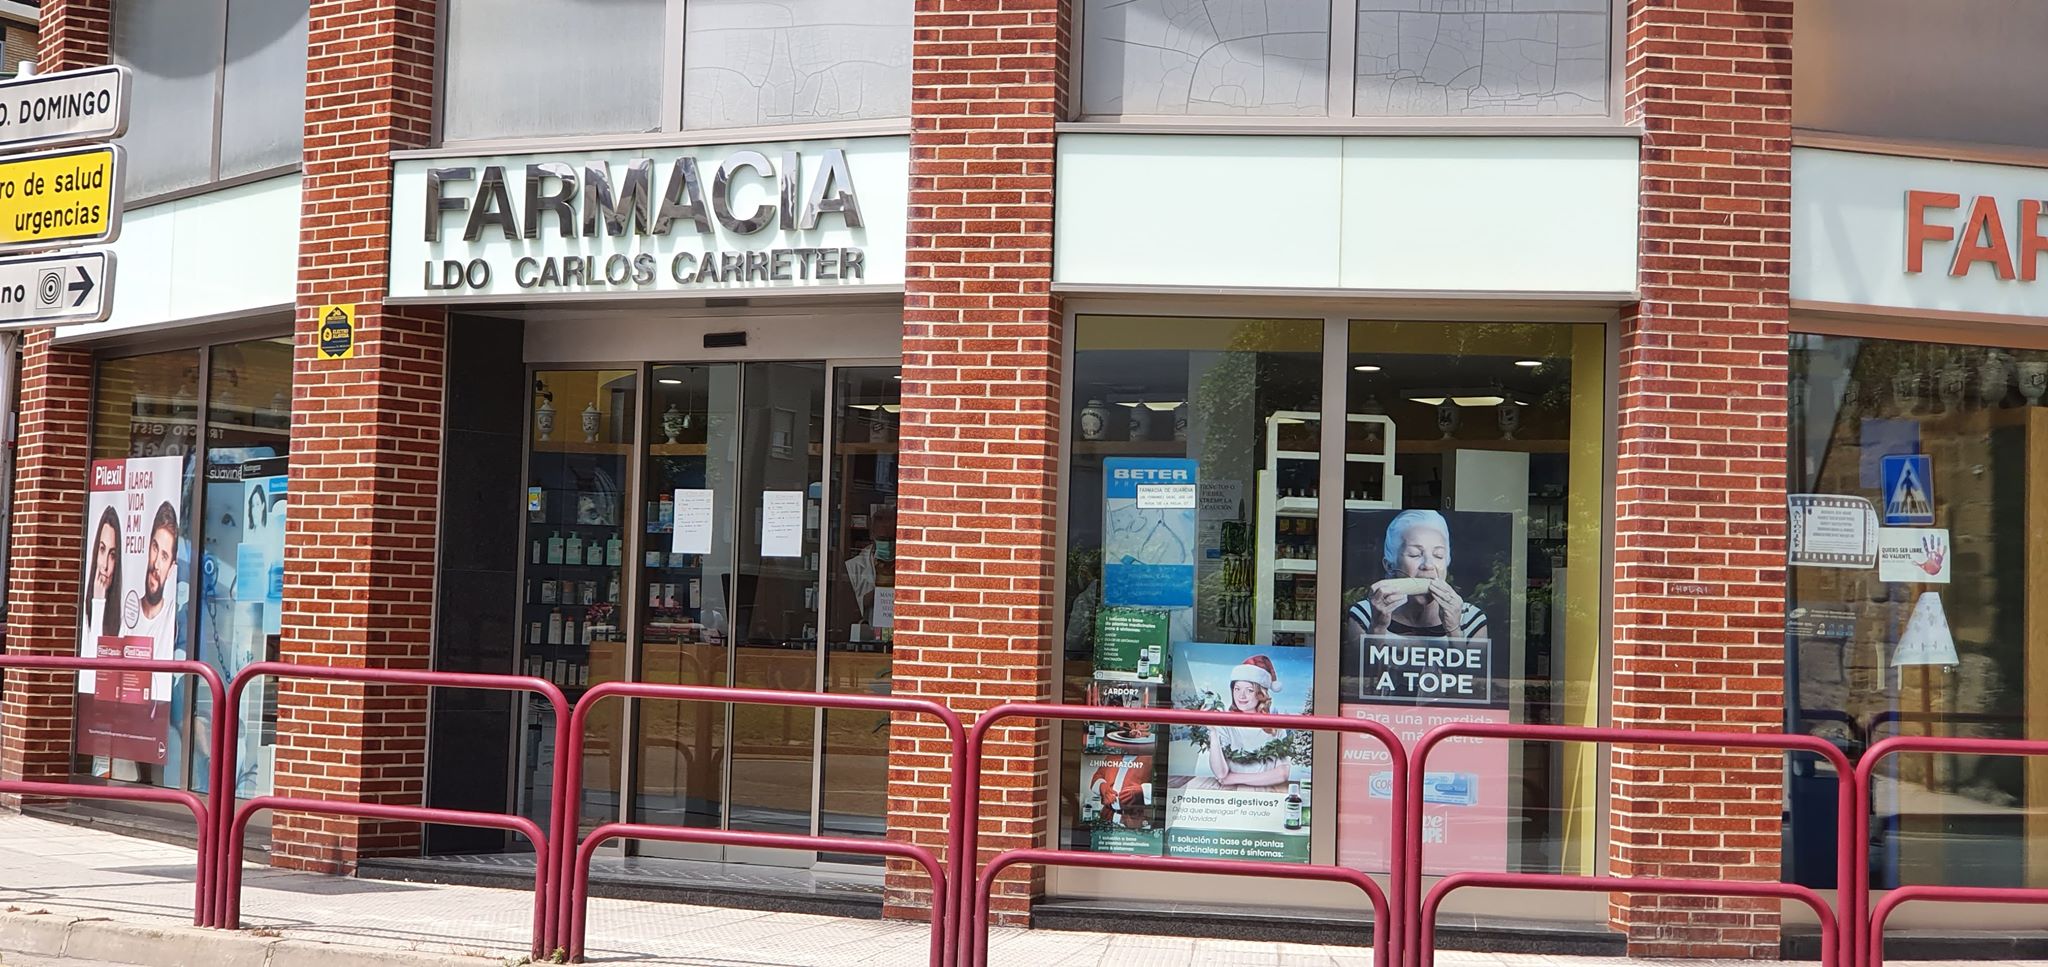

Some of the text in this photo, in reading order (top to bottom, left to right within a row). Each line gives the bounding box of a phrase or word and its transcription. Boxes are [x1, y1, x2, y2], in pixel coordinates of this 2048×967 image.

[19, 89, 111, 124] DOMINGO
[24, 172, 45, 196] de
[54, 164, 104, 193] salud
[424, 148, 865, 243] FARMACIA
[15, 202, 101, 234] urgencias
[424, 248, 865, 290] LDO CARLOS CARRETER
[95, 465, 124, 486] Pilexil
[128, 471, 153, 489] ¡LARGA
[1114, 468, 1188, 480] BETER
[128, 493, 144, 511] VIDA
[126, 515, 142, 532] A MI
[125, 536, 145, 554] PELO!
[1370, 645, 1482, 668] MUERDE
[1376, 671, 1473, 694] A TOPE
[1356, 711, 1390, 725] Para
[1395, 714, 1423, 725] una
[1402, 728, 1425, 741] má
[1343, 750, 1389, 760] NUEVO
[1090, 760, 1144, 769] ¿HINCHAZÓN?
[1171, 795, 1279, 808] ¿Problemas digestivos?
[1187, 815, 1217, 823] Navidad
[1248, 810, 1271, 818] ayude
[1177, 834, 1211, 844] solución
[1220, 836, 1240, 846] base
[1241, 837, 1252, 847] de
[1253, 838, 1284, 849] plantas
[1170, 845, 1284, 859] medicinales para 6 síntomas:
